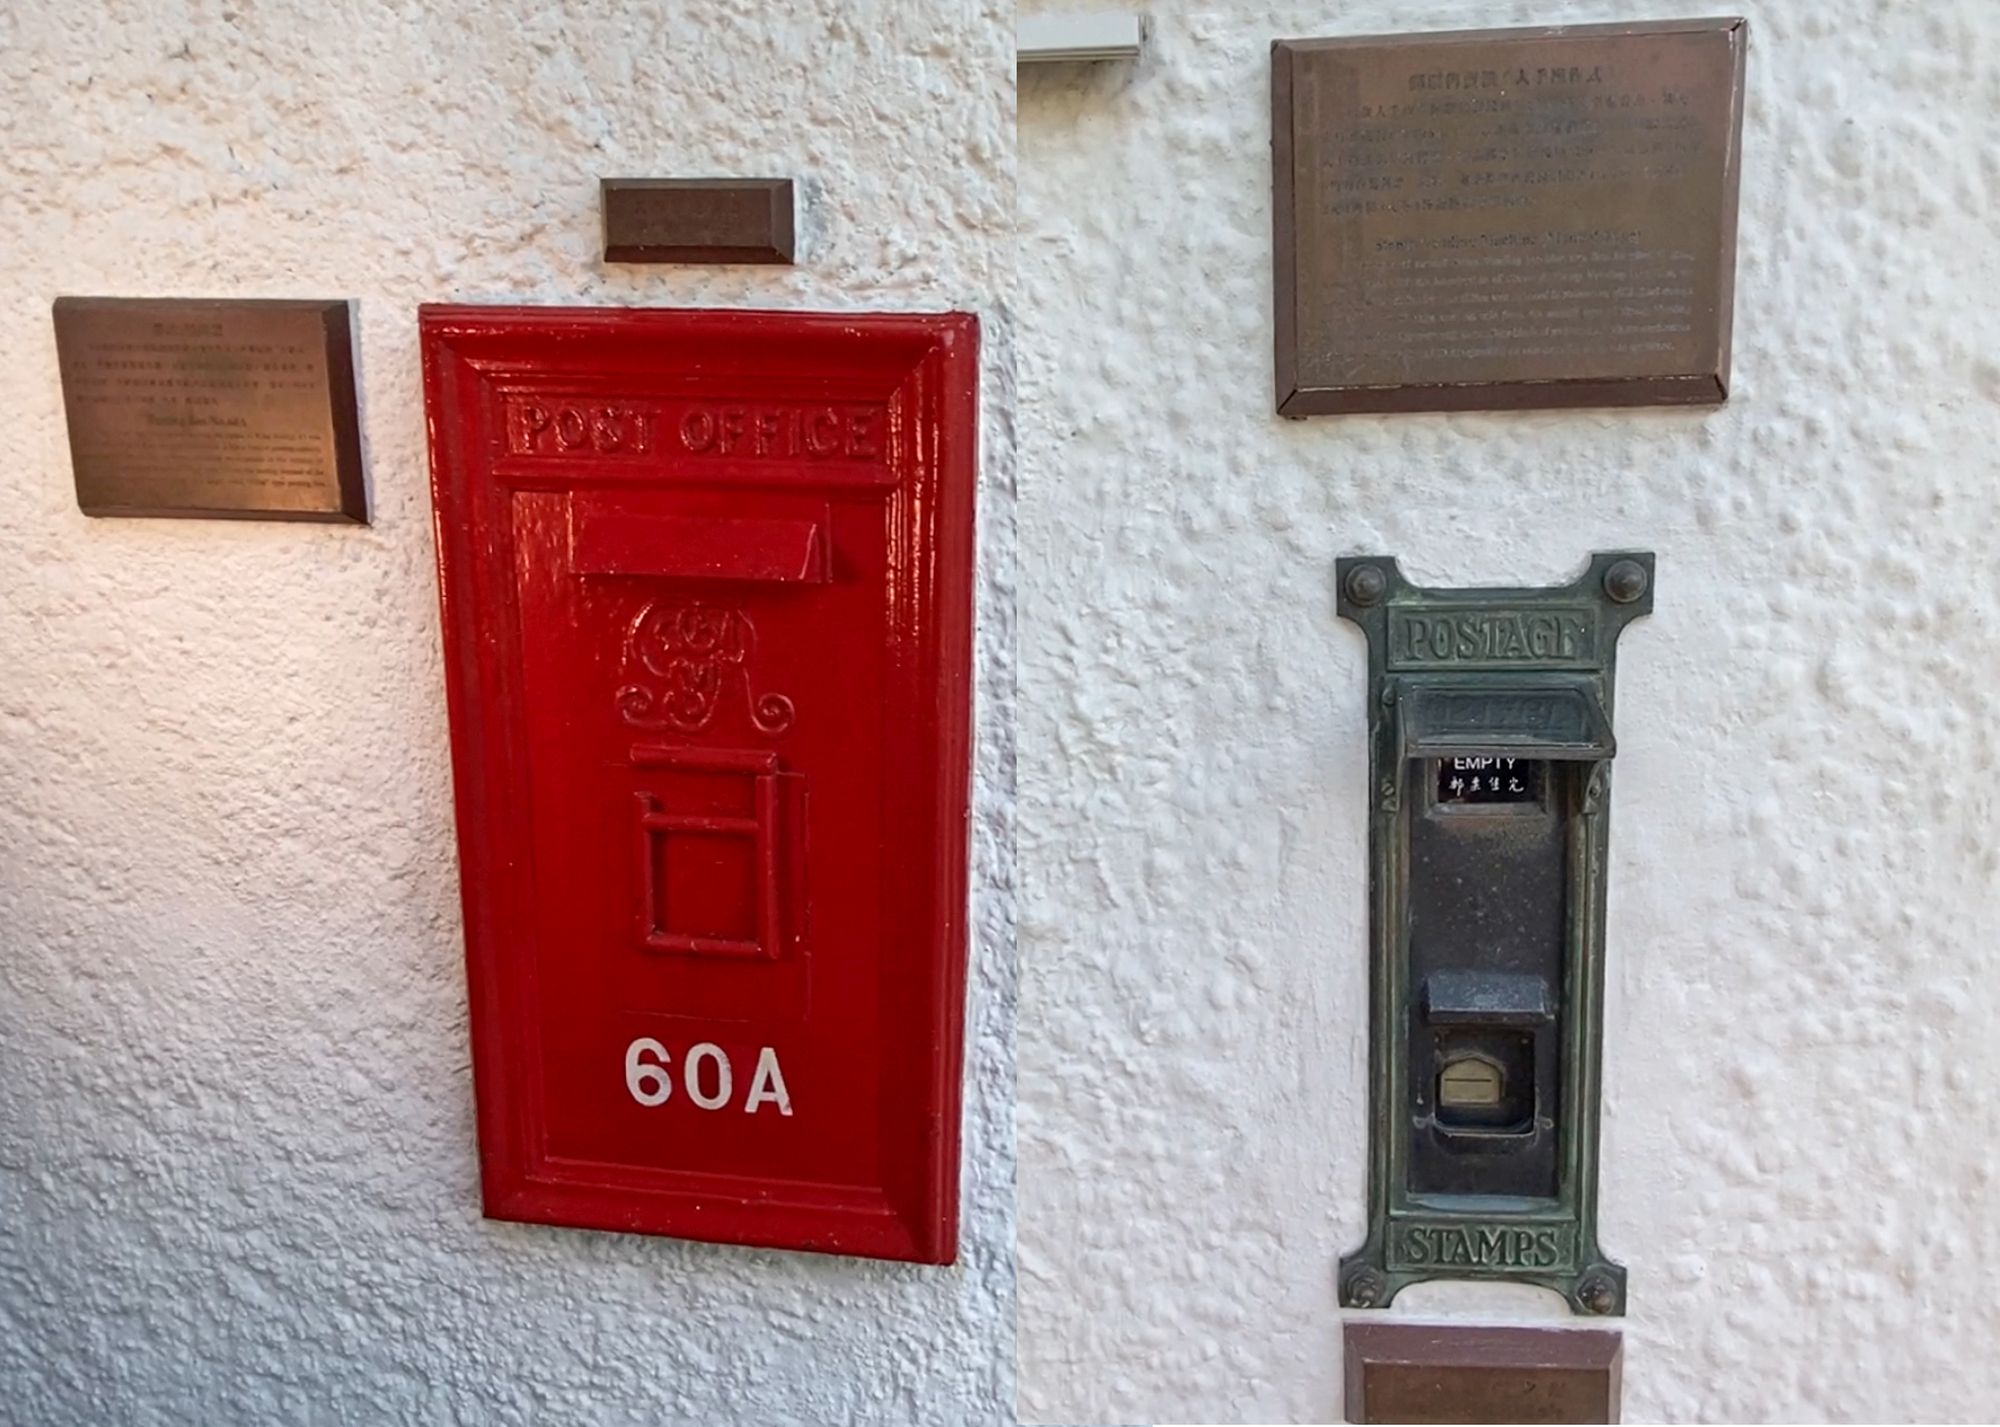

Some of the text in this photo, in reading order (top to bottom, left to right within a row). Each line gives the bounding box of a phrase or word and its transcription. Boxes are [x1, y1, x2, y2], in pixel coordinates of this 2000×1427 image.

[520, 404, 880, 458] POST OFFICE
[1404, 613, 1580, 661] POSTAGE
[1454, 757, 1516, 770] EMPTY
[625, 1037, 794, 1116] 60A
[1404, 1225, 1560, 1267] STAMPS
